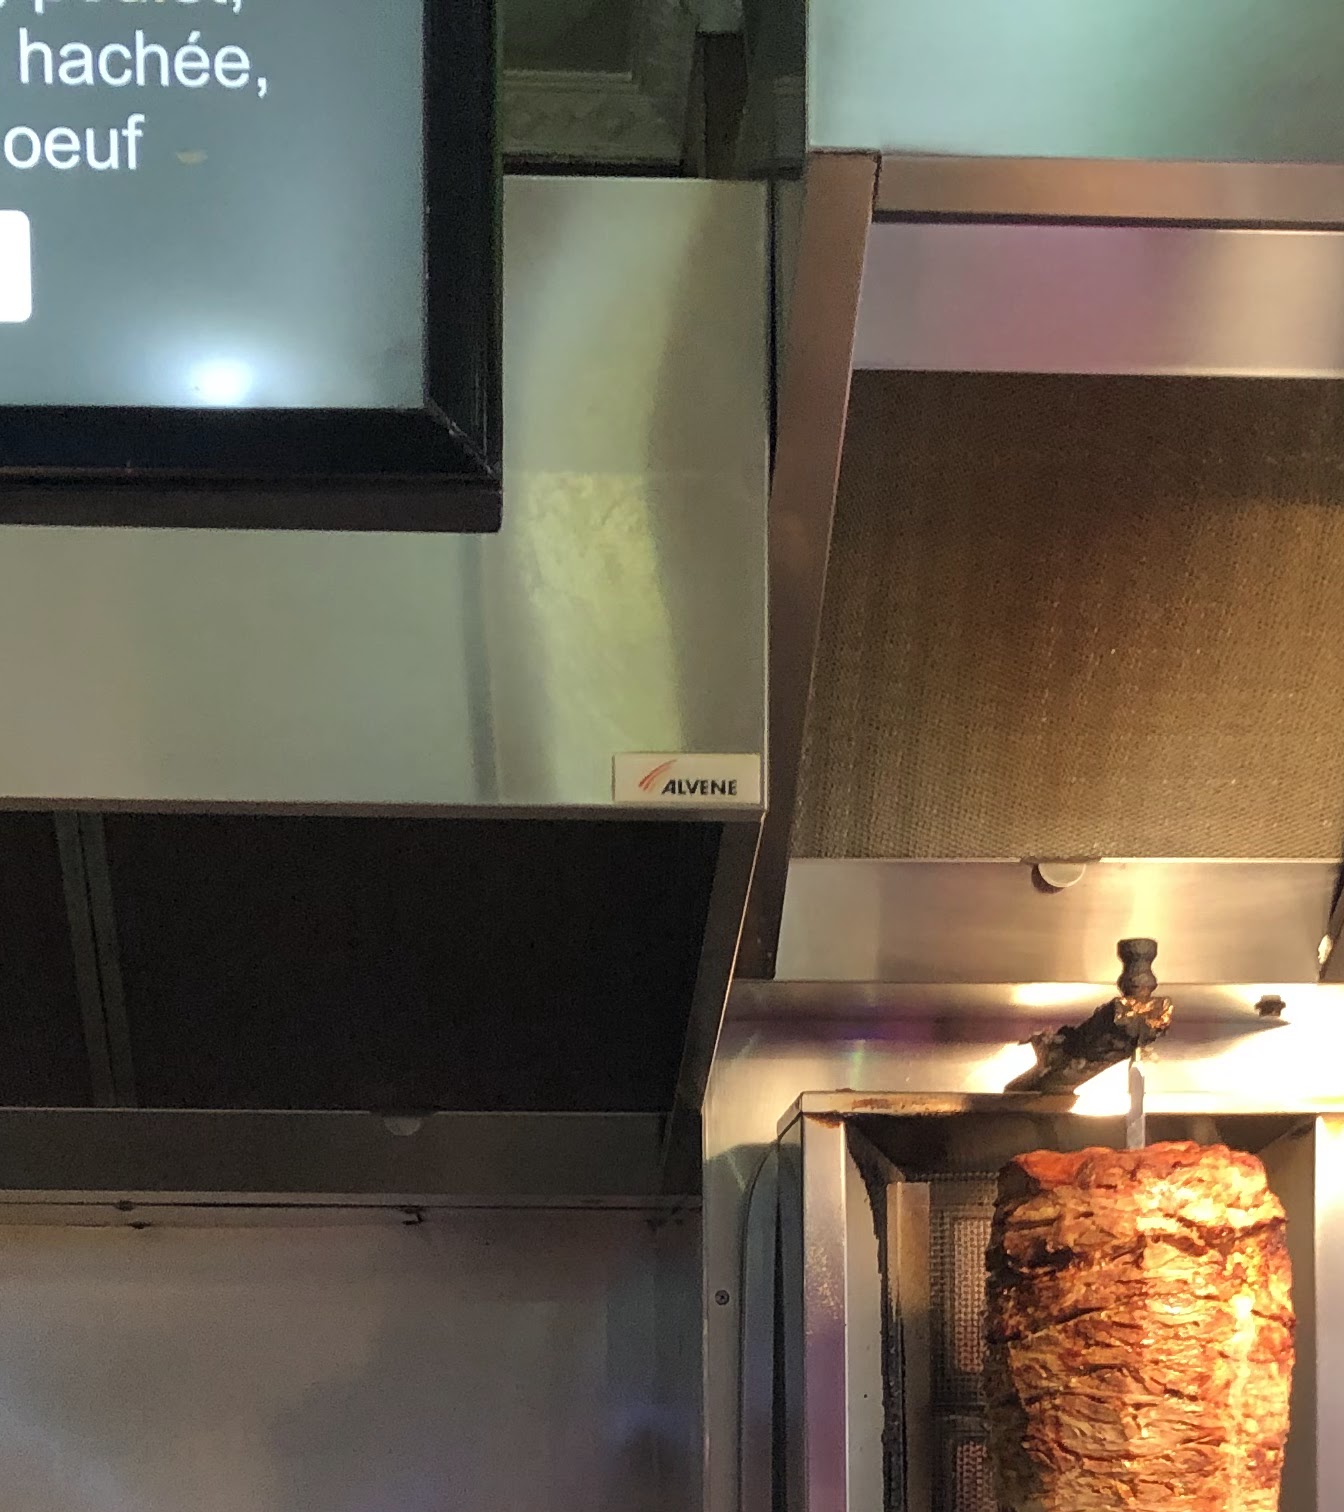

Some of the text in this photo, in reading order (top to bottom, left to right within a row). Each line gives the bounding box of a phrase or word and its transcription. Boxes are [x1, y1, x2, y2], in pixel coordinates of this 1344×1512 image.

[19, 27, 267, 97] hachée,
[4, 113, 145, 170] oeuf
[661, 778, 738, 796] ALVENE
